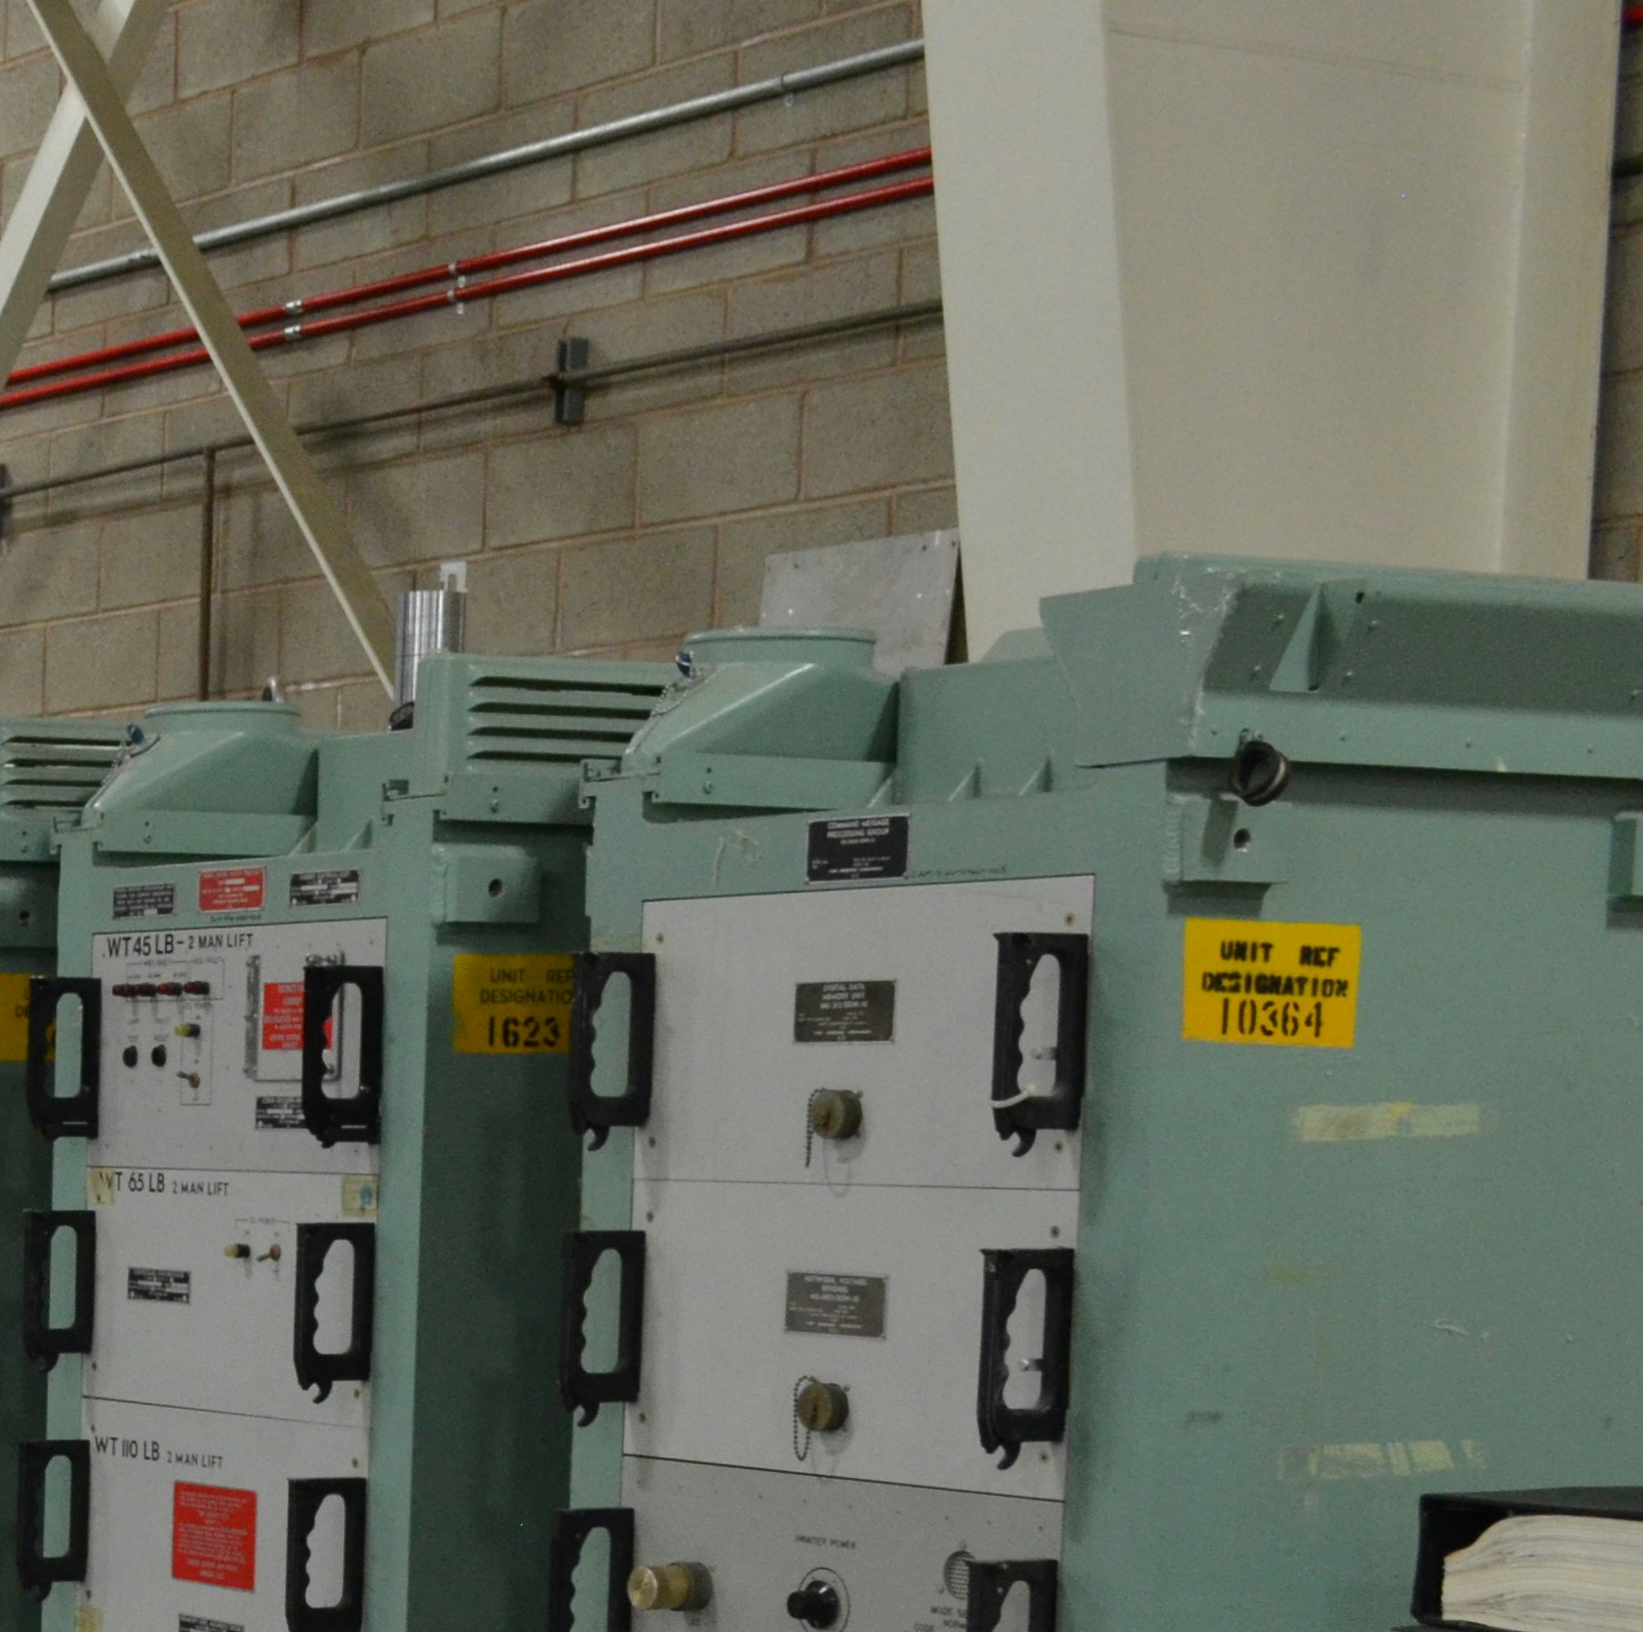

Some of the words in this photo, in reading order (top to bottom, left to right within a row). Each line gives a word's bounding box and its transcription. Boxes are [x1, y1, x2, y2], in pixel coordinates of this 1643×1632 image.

[188, 936, 194, 949] 2
[198, 935, 222, 949] MAN
[226, 933, 253, 948] LIFT
[1220, 941, 1273, 964] UNIT
[1299, 944, 1340, 967] REF
[490, 968, 526, 983] UNIT
[1202, 972, 1348, 998] DESIGNATION
[480, 988, 573, 1004] DESIGNATIO
[489, 1016, 559, 1047] 1623
[1221, 1000, 1324, 1038] 10364
[128, 1173, 145, 1192] 65
[148, 1173, 165, 1193] LB
[172, 1181, 178, 1194] 2
[181, 1182, 205, 1195] MAN
[208, 1183, 229, 1196] LIFT
[95, 1435, 117, 1456] WT
[122, 1439, 138, 1458] 110
[143, 1441, 160, 1461] LB
[167, 1451, 172, 1463] 2
[176, 1452, 198, 1466] MAN
[201, 1455, 223, 1469] LIFT
